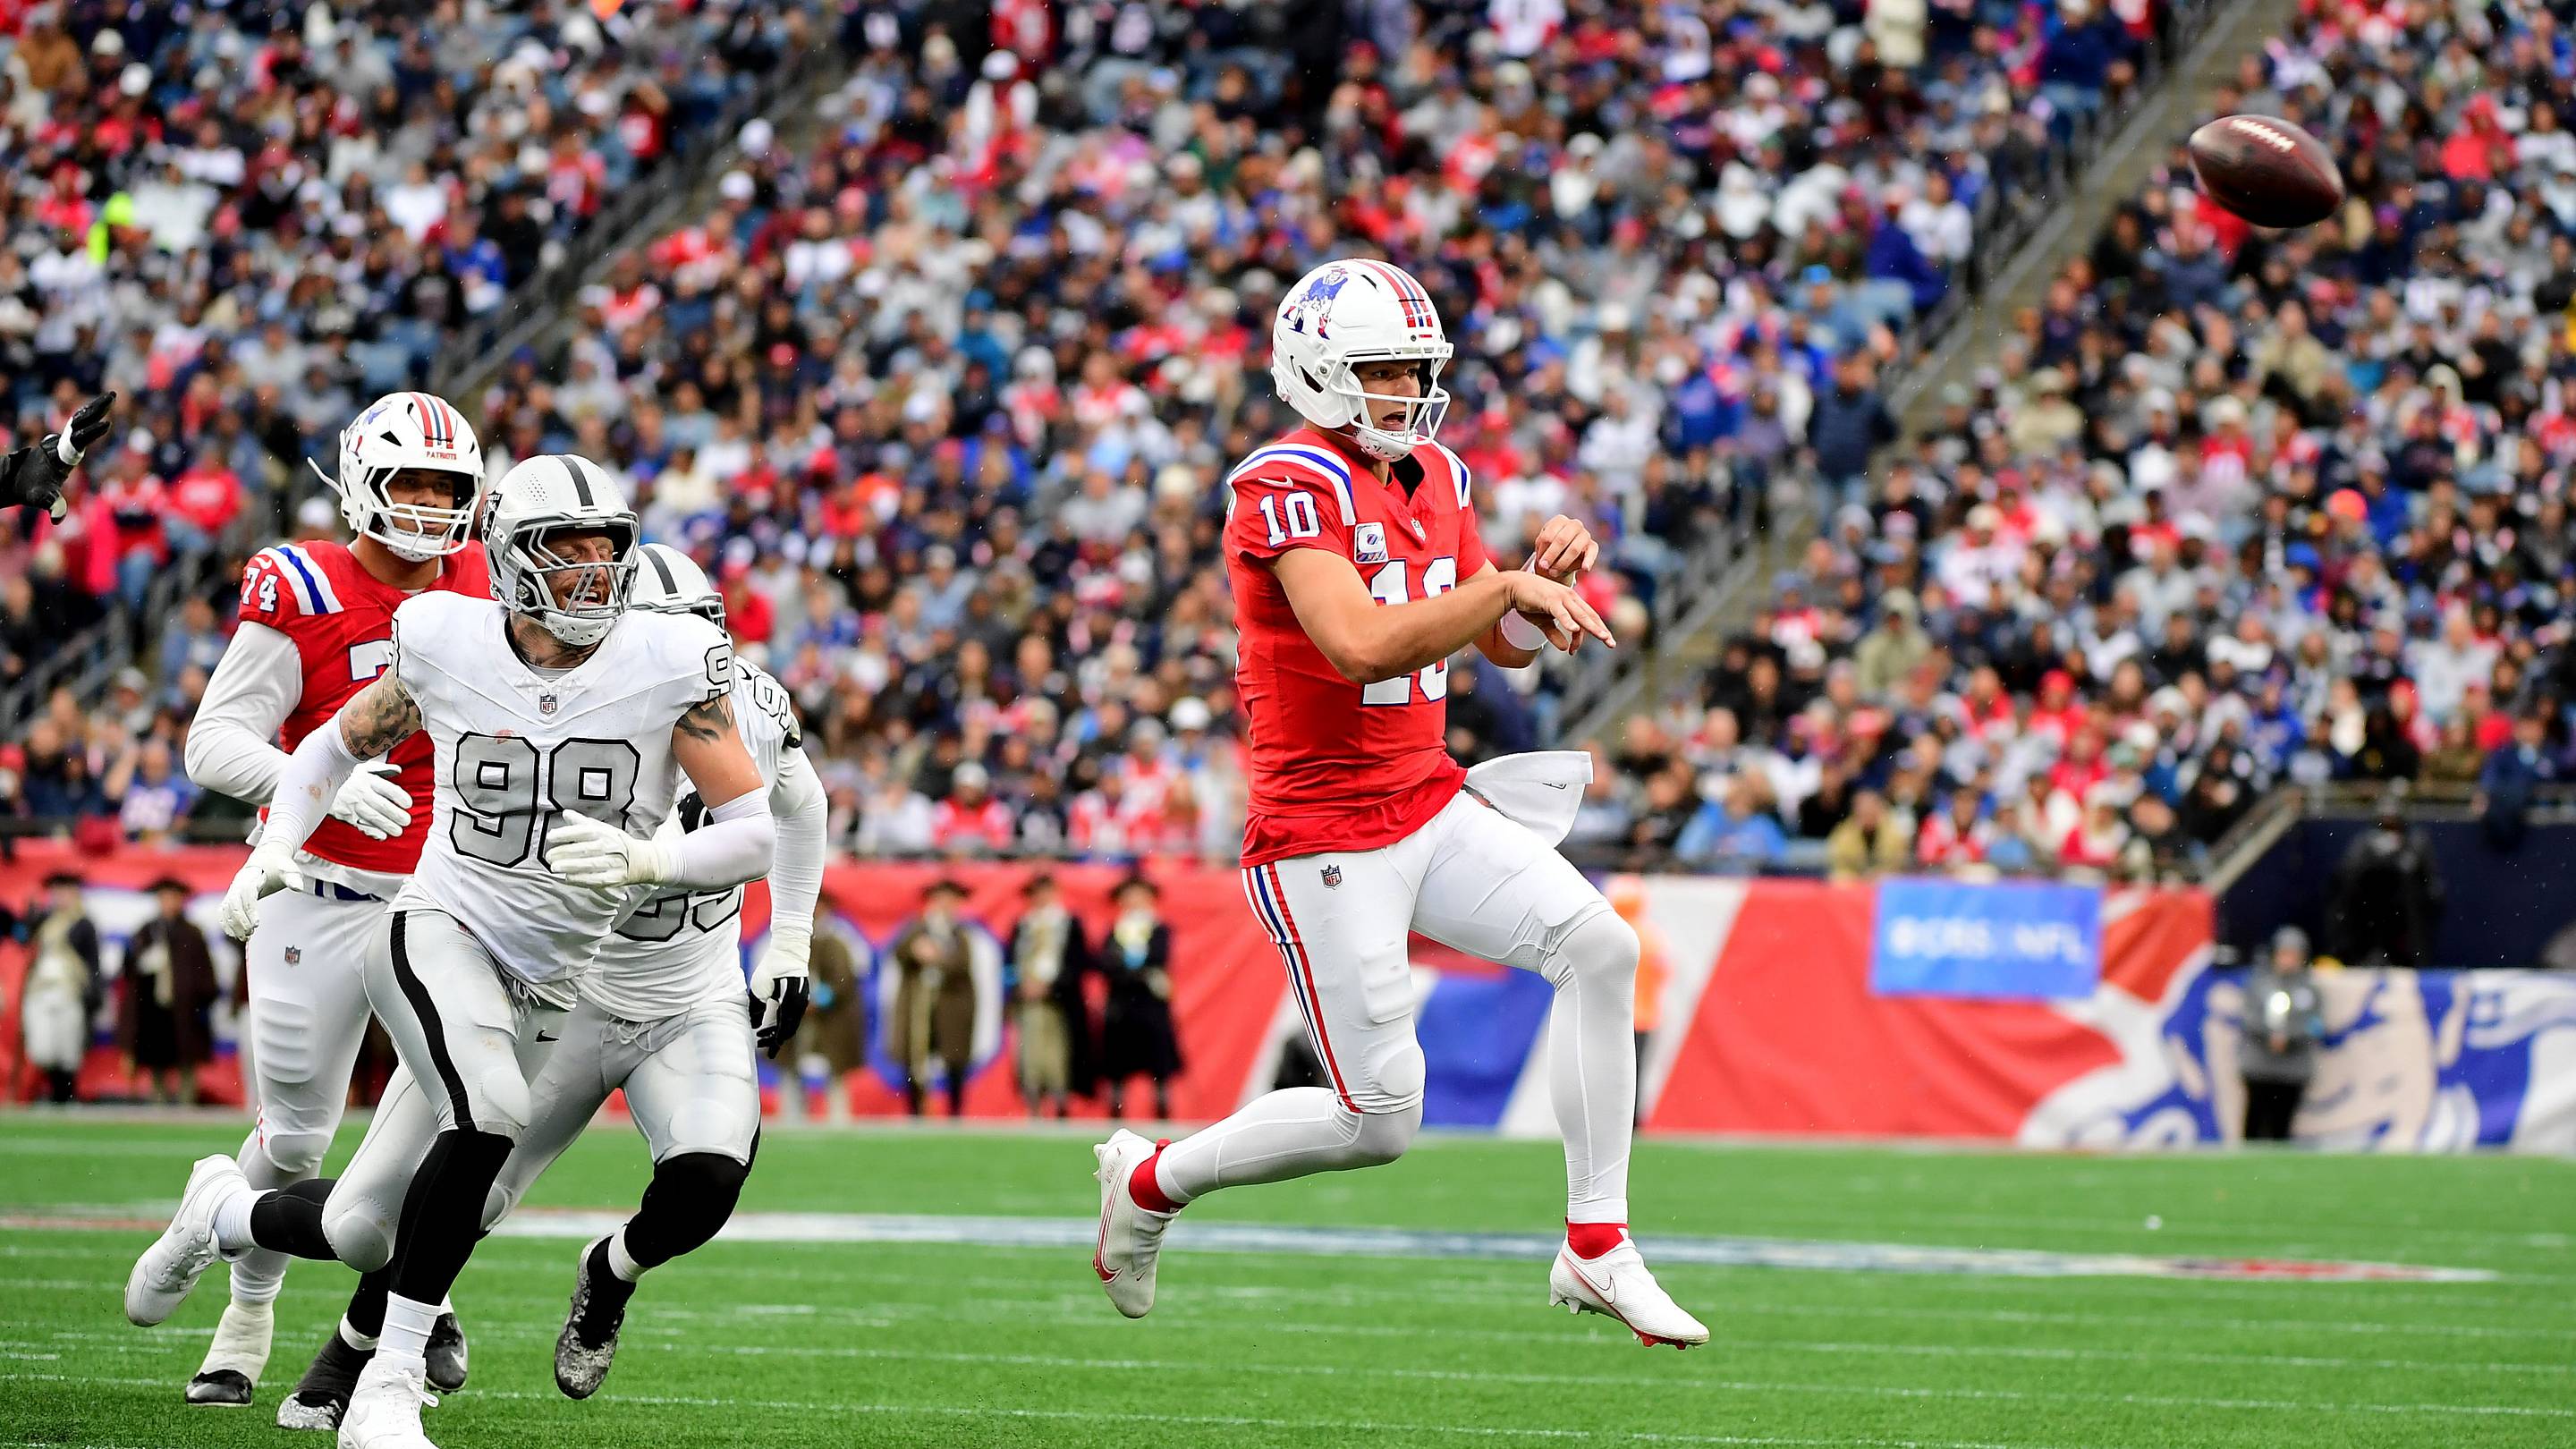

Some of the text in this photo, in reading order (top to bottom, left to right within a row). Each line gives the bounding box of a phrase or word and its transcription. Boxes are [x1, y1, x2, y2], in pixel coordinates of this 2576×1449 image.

[426, 450, 457, 461] PATRIOTS
[1259, 490, 1321, 547] 10
[242, 566, 279, 613] 74
[542, 702, 555, 712] NFL
[449, 730, 641, 874] 98
[1326, 875, 1340, 885] NFL
